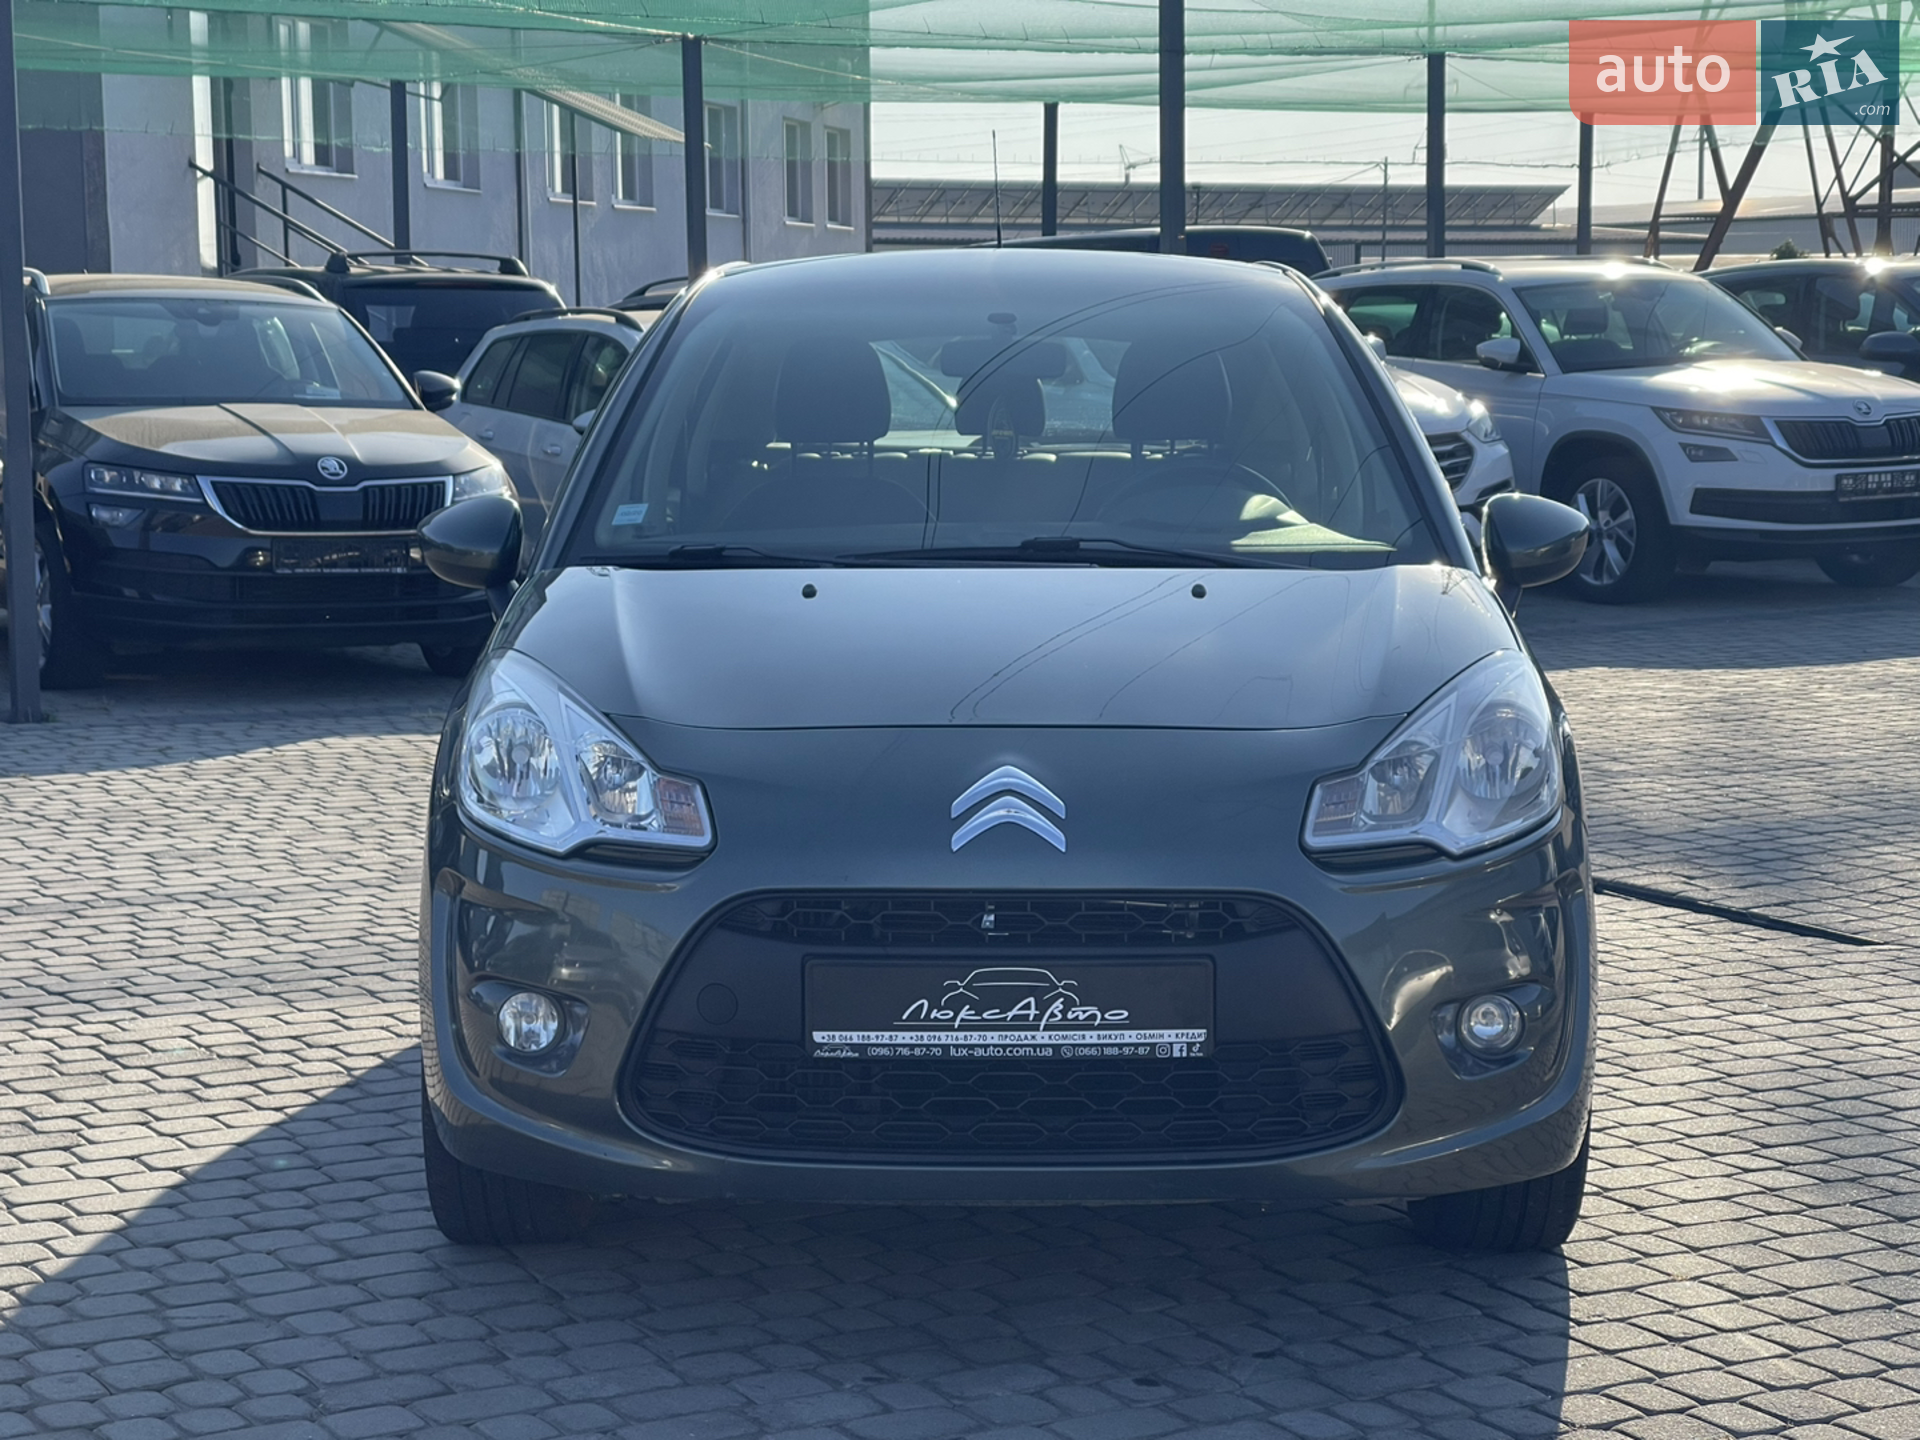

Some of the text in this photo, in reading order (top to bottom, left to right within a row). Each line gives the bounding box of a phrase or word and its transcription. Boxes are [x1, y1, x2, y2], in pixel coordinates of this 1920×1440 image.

[821, 1034, 836, 1042] +38
[856, 1034, 899, 1042] 188-97-87
[909, 1034, 924, 1042] +38
[926, 1034, 942, 1042] 096
[944, 1033, 988, 1042] 716-87-70
[997, 1033, 1038, 1042] ПРОДАЖ
[1047, 1033, 1087, 1042] КОМІСІЯ
[1096, 1032, 1126, 1041] ВИКУП
[1135, 1032, 1165, 1041] ОБМІН
[867, 1046, 894, 1057] (096)
[895, 1046, 942, 1057] 716-87-70
[949, 1045, 1053, 1057] lux-auto.com.ua
[1074, 1046, 1102, 1057] (066)
[1102, 1046, 1151, 1056] 188-97-87
